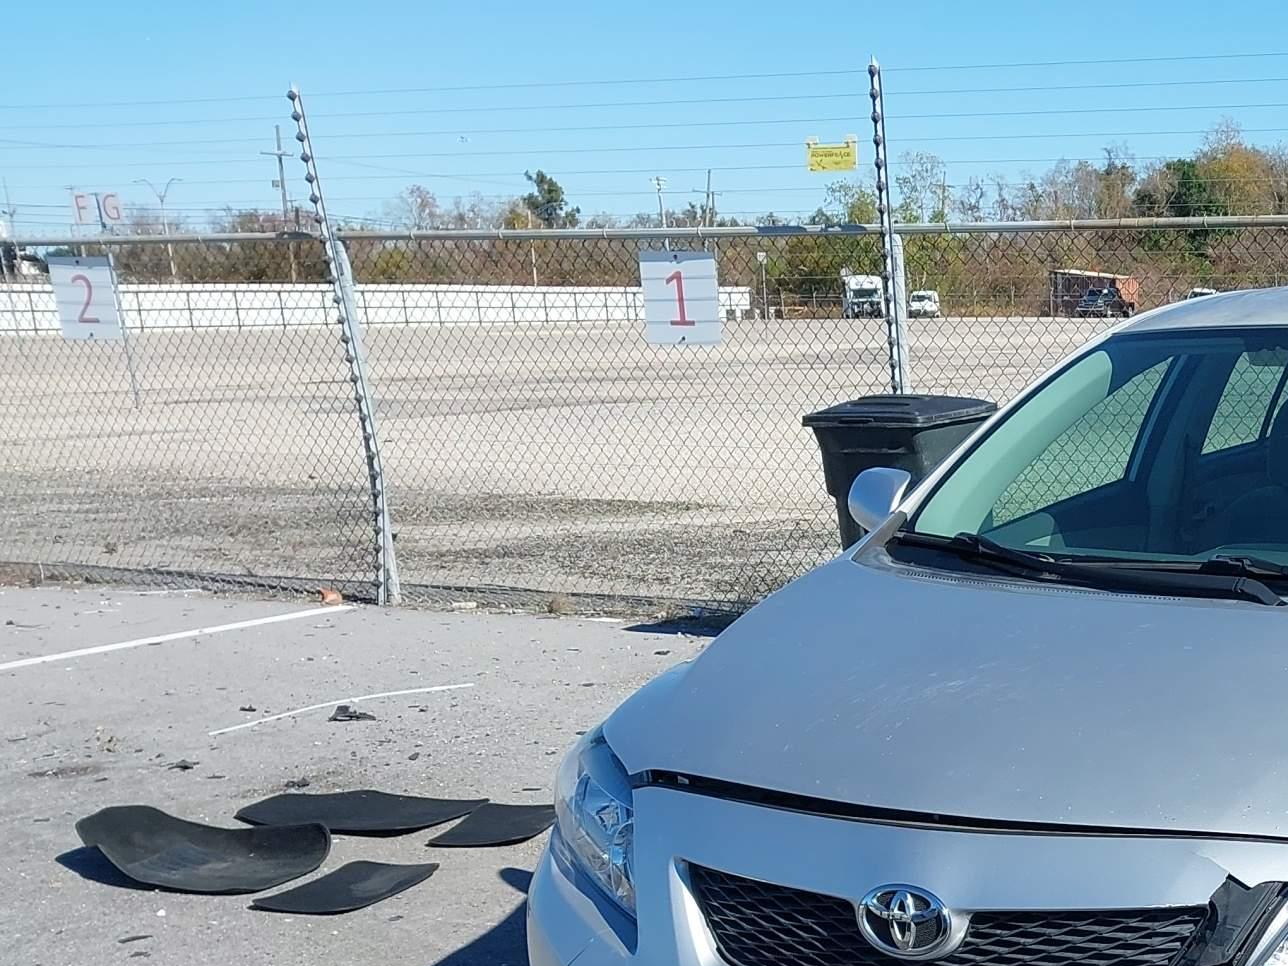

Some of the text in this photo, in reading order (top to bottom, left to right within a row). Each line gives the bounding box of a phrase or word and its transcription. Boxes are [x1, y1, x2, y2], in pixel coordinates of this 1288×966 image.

[75, 195, 87, 222] F
[102, 194, 121, 220] G
[71, 274, 101, 323] 2
[665, 270, 695, 327] 1
